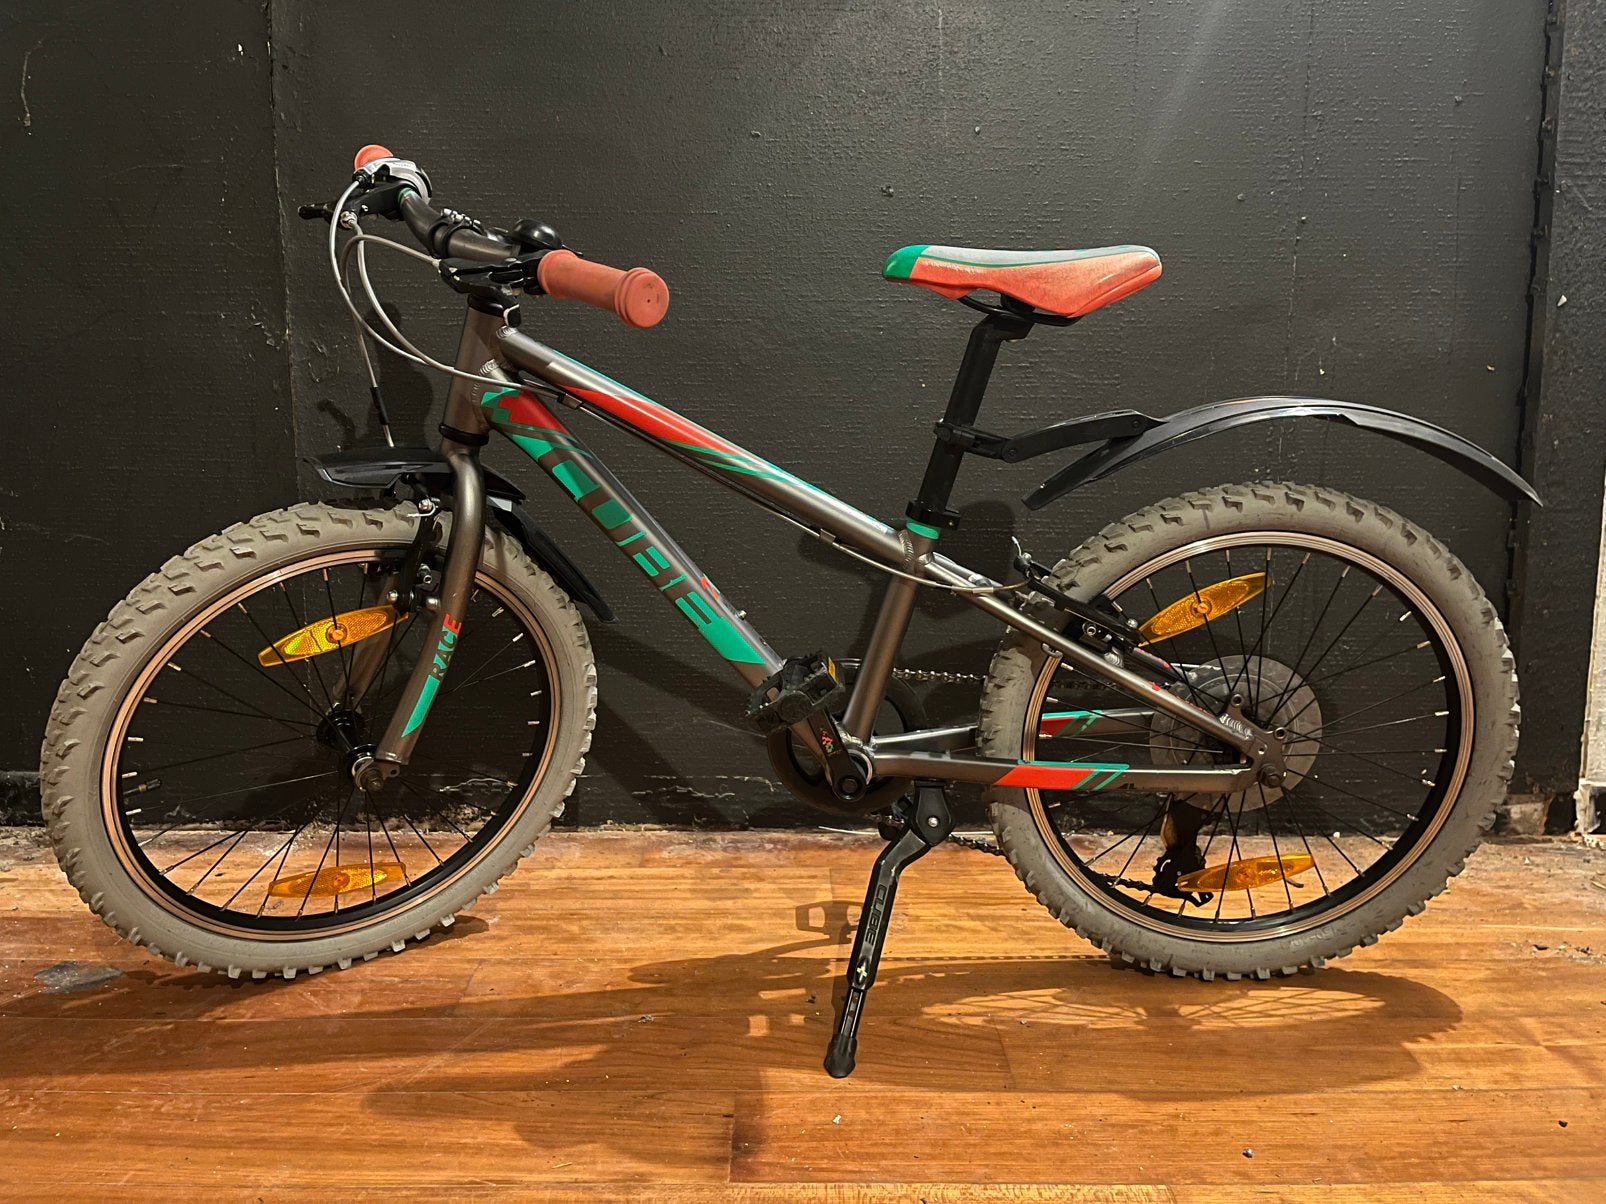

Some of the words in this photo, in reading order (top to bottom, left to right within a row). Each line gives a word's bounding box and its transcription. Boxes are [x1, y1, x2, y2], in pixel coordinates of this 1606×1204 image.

[536, 446, 724, 633] CUBE
[429, 612, 463, 681] RACE
[864, 883, 888, 946] CUBE
